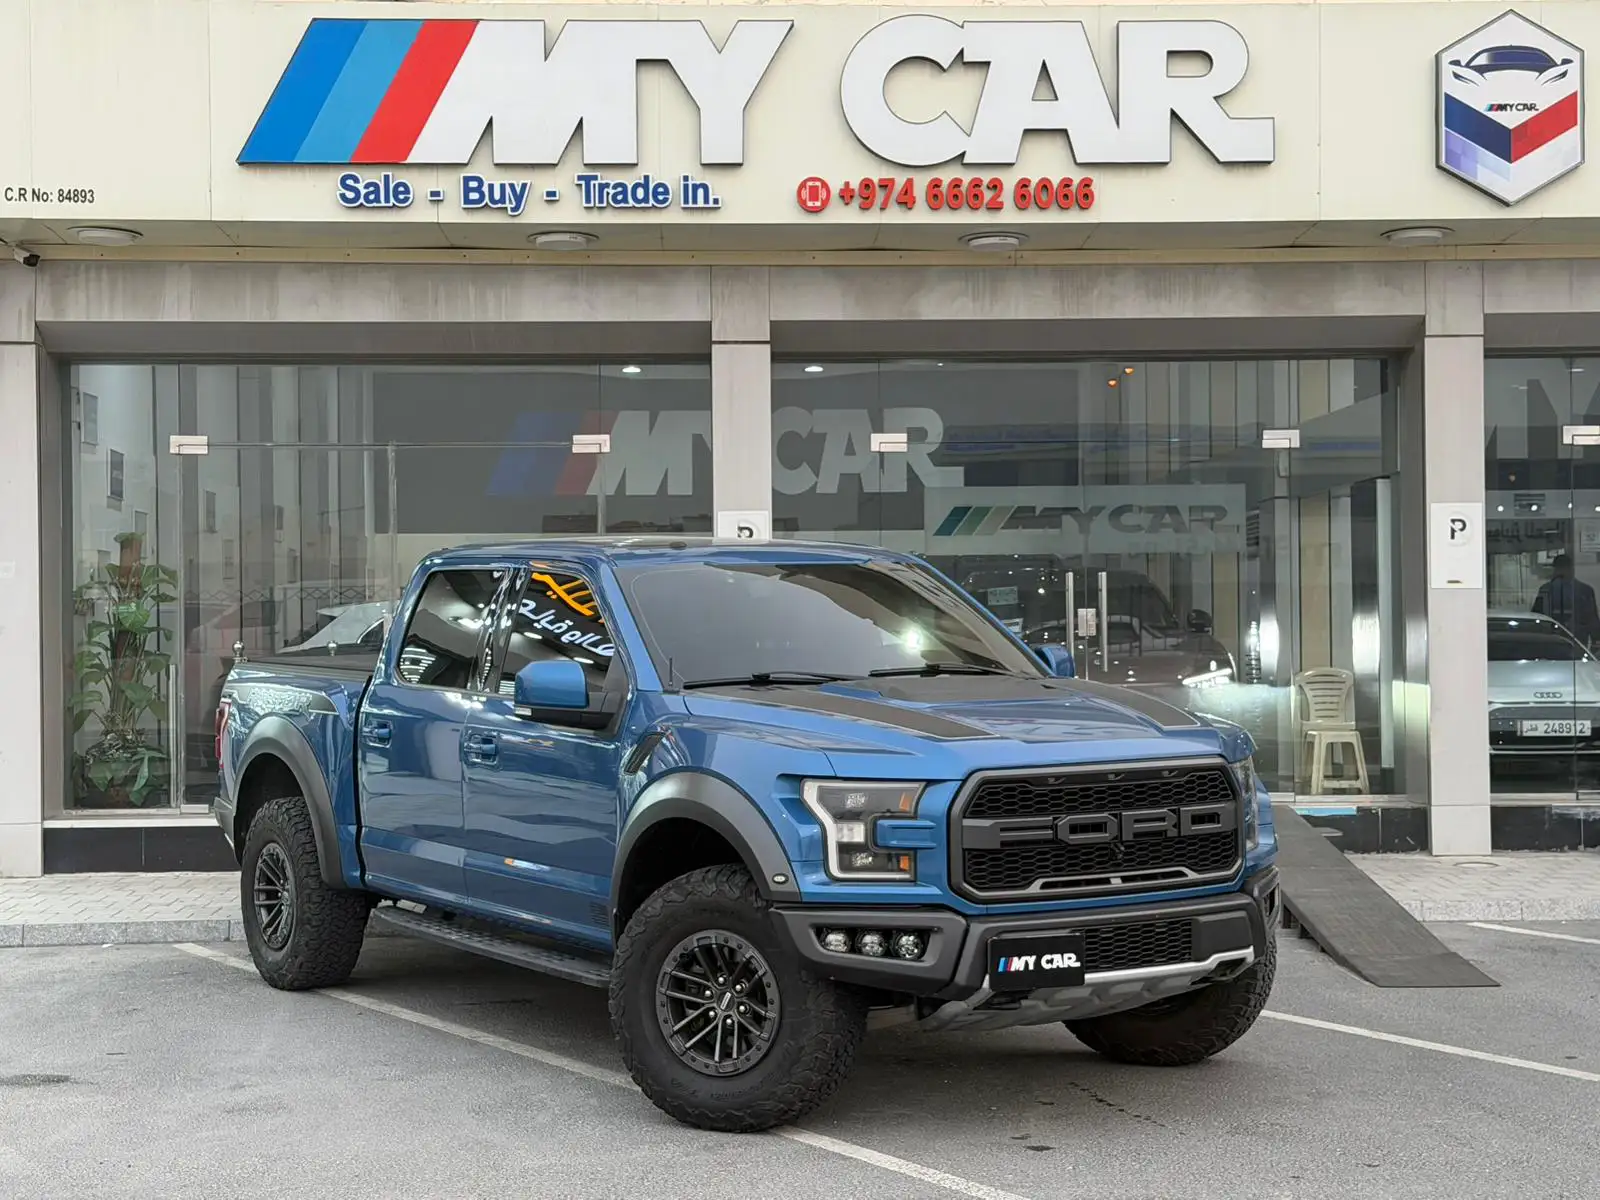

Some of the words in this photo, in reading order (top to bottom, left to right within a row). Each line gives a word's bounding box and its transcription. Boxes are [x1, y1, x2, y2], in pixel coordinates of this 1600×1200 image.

[405, 19, 793, 165] MY
[840, 14, 1276, 166] CAR
[4, 187, 28, 202] C.R
[31, 188, 54, 203] No:
[57, 188, 95, 204] 84893
[337, 172, 413, 208] Sale
[461, 174, 531, 216] Buy
[575, 174, 672, 208] Trade
[680, 174, 722, 208] in.
[838, 177, 917, 210] +974
[925, 177, 1005, 210] 6662
[1013, 177, 1095, 210] 6066
[588, 410, 712, 496] M
[772, 407, 965, 494] CAR
[1544, 722, 1586, 735] 24892
[962, 803, 1238, 850] FORD
[1010, 955, 1037, 971] MY
[1041, 953, 1081, 969] CAR
